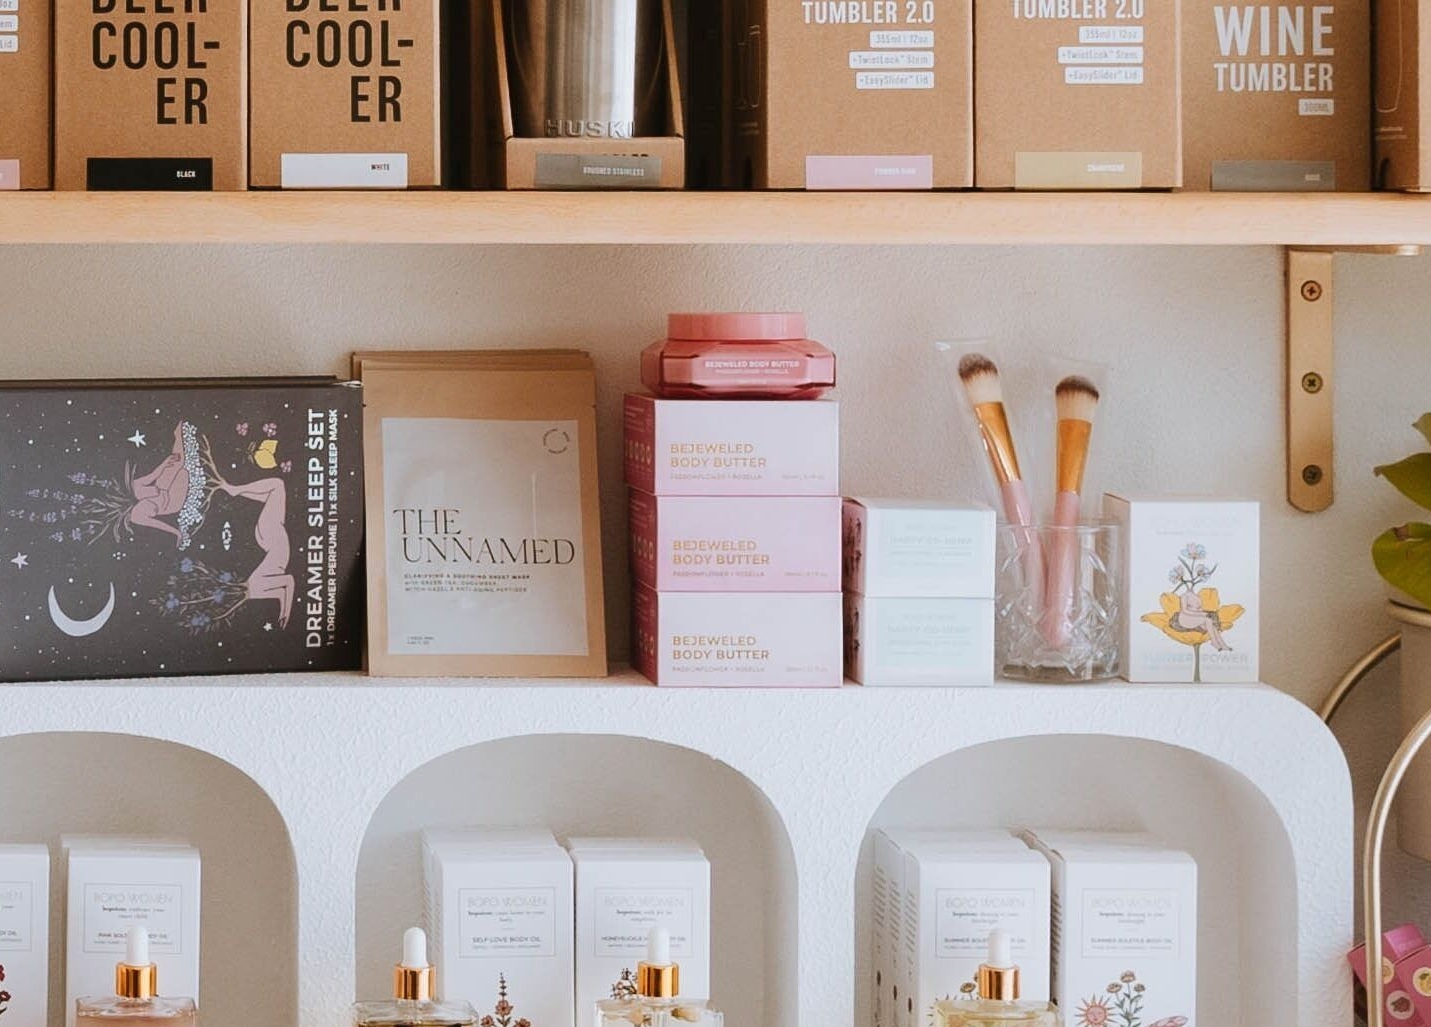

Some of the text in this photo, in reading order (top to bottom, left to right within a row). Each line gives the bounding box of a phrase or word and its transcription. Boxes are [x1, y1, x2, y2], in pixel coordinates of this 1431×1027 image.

[801, 0, 935, 25] TUMBLER 2.0
[1012, 0, 1144, 20] TUMBLER 2.0
[285, 19, 414, 69] COOL-
[1213, 6, 1334, 56] WINE
[92, 21, 219, 70] COOL-
[1213, 63, 1332, 92] TUMBLER
[156, 77, 208, 126] ER
[350, 76, 403, 123] ER
[544, 118, 635, 139] HUSKI
[176, 169, 197, 179] BLACK
[329, 408, 339, 442] MASK
[329, 442, 338, 477] SLEEP
[669, 443, 754, 454] BEJEWELED
[669, 457, 767, 468] BODY BUTTER
[329, 478, 338, 501] SILK
[305, 408, 325, 648] DREAMER SLEEP SET
[392, 508, 462, 536] THE
[327, 524, 338, 576] PERFUME
[403, 537, 576, 565] UNNAMED
[671, 540, 756, 551] BEJEWELED
[671, 554, 769, 565] BODY BUTTER
[326, 578, 337, 632] DREAMER
[671, 635, 756, 646] BEJEWELED
[671, 649, 769, 660] BODY BUTTER
